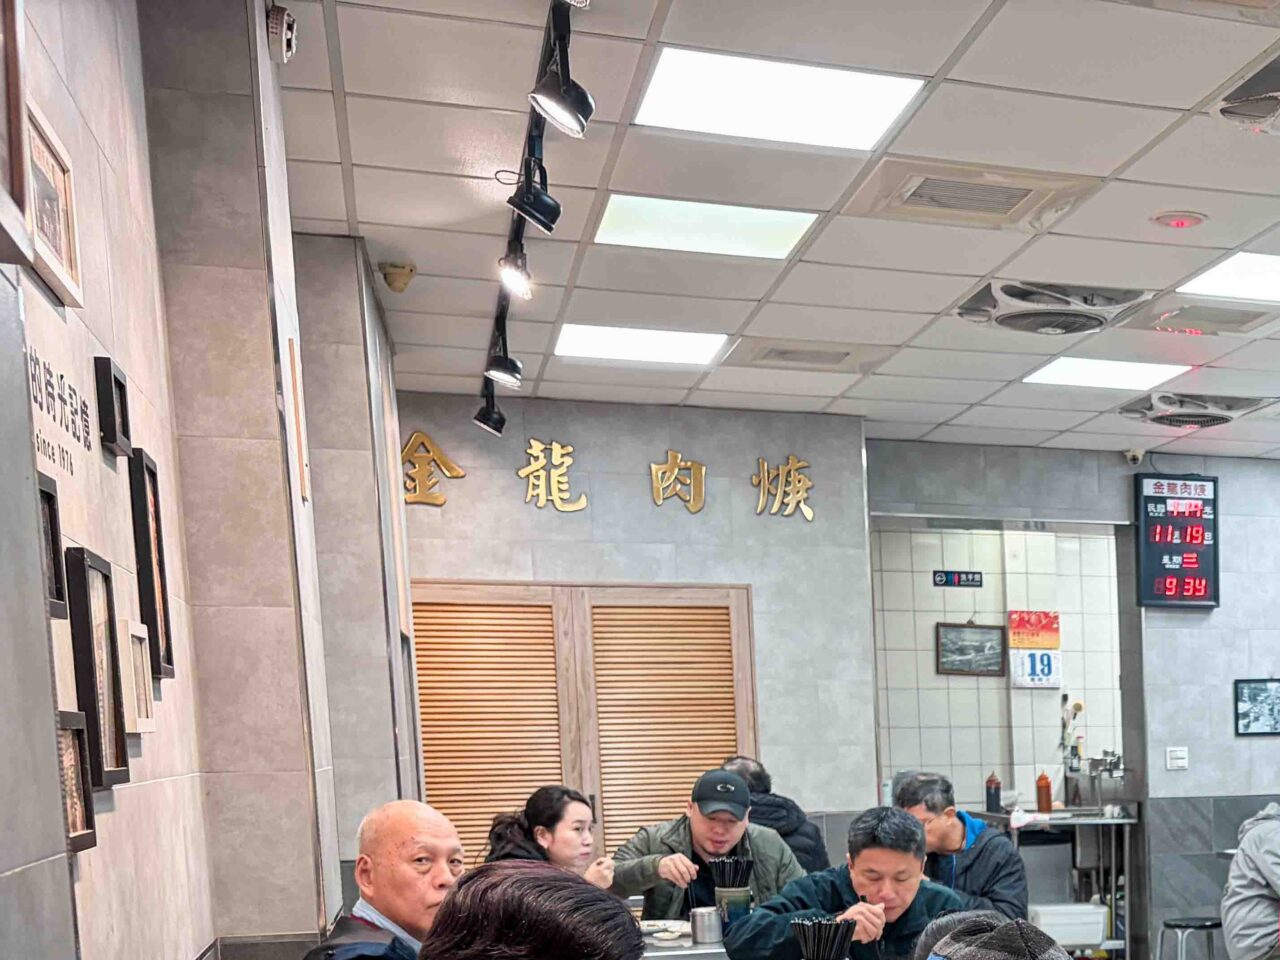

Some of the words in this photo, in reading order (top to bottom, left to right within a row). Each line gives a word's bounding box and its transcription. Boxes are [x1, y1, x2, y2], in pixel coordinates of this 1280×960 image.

[36, 429, 56, 464] since
[58, 444, 74, 476] 1976
[1028, 652, 1053, 677] 19
